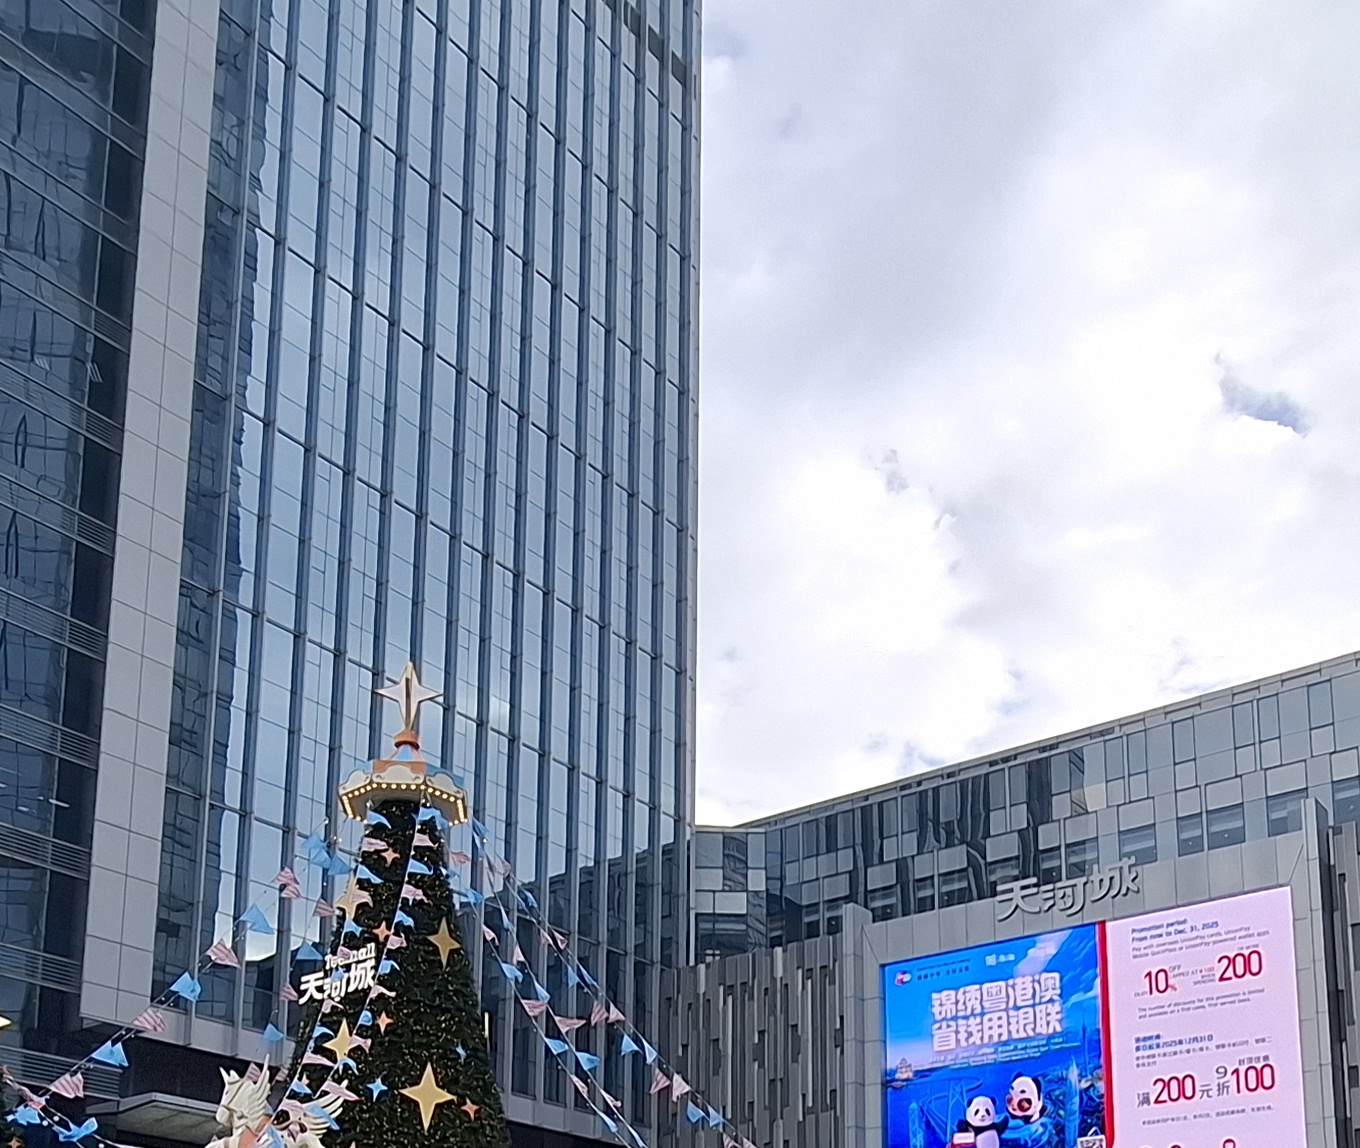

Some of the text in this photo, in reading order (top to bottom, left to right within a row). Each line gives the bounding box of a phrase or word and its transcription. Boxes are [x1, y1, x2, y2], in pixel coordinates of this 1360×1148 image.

[996, 855, 1140, 922] 天河城
[299, 958, 376, 1005] 天河城
[1217, 949, 1262, 982] 200
[930, 971, 1061, 1020] 锦绣粤港澳
[931, 1002, 1064, 1053] 省钱用银联
